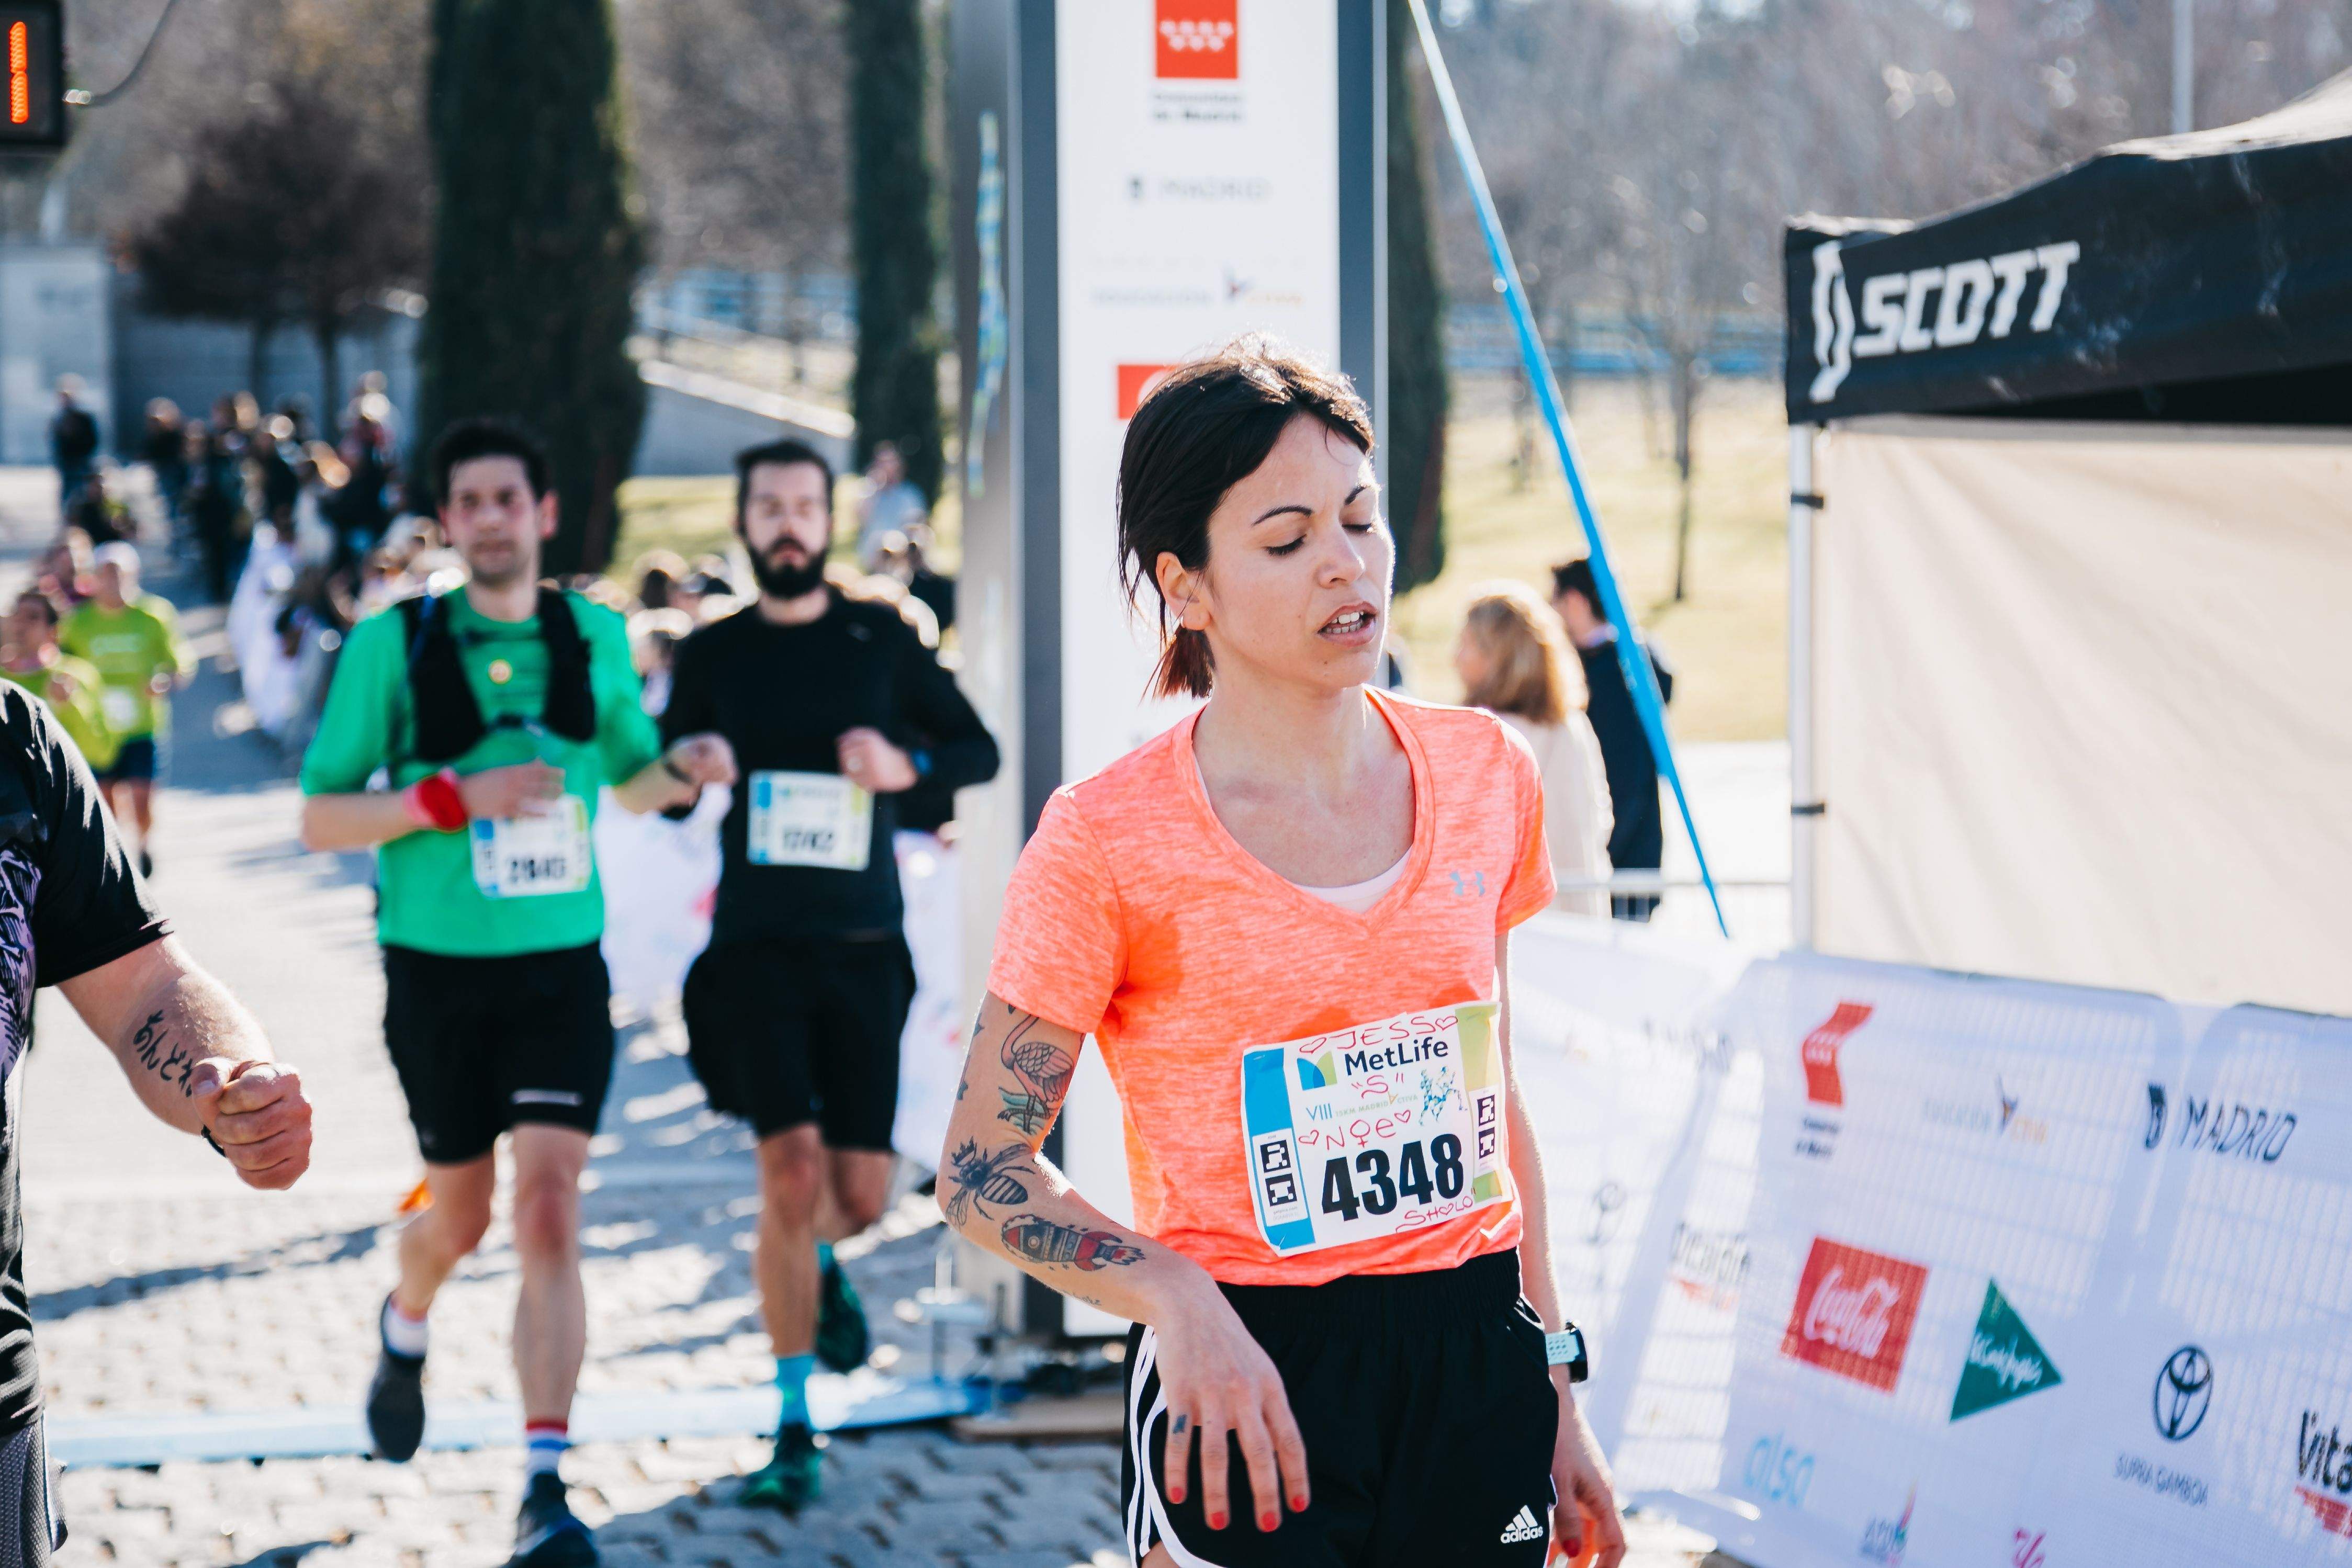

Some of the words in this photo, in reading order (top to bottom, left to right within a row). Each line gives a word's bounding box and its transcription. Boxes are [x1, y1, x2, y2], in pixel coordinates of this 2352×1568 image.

[1853, 240, 2080, 357] SCOTT
[1330, 1016, 1436, 1050] JESS
[1344, 1036, 1448, 1076] MetLife
[1306, 1103, 1333, 1121] VIII
[1358, 1101, 1389, 1113] MADRID
[2180, 1095, 2297, 1163] MADRID
[1321, 1133, 1464, 1222] 4348
[1744, 1434, 1816, 1506] alsa
[1500, 1526, 1544, 1543] adidas
